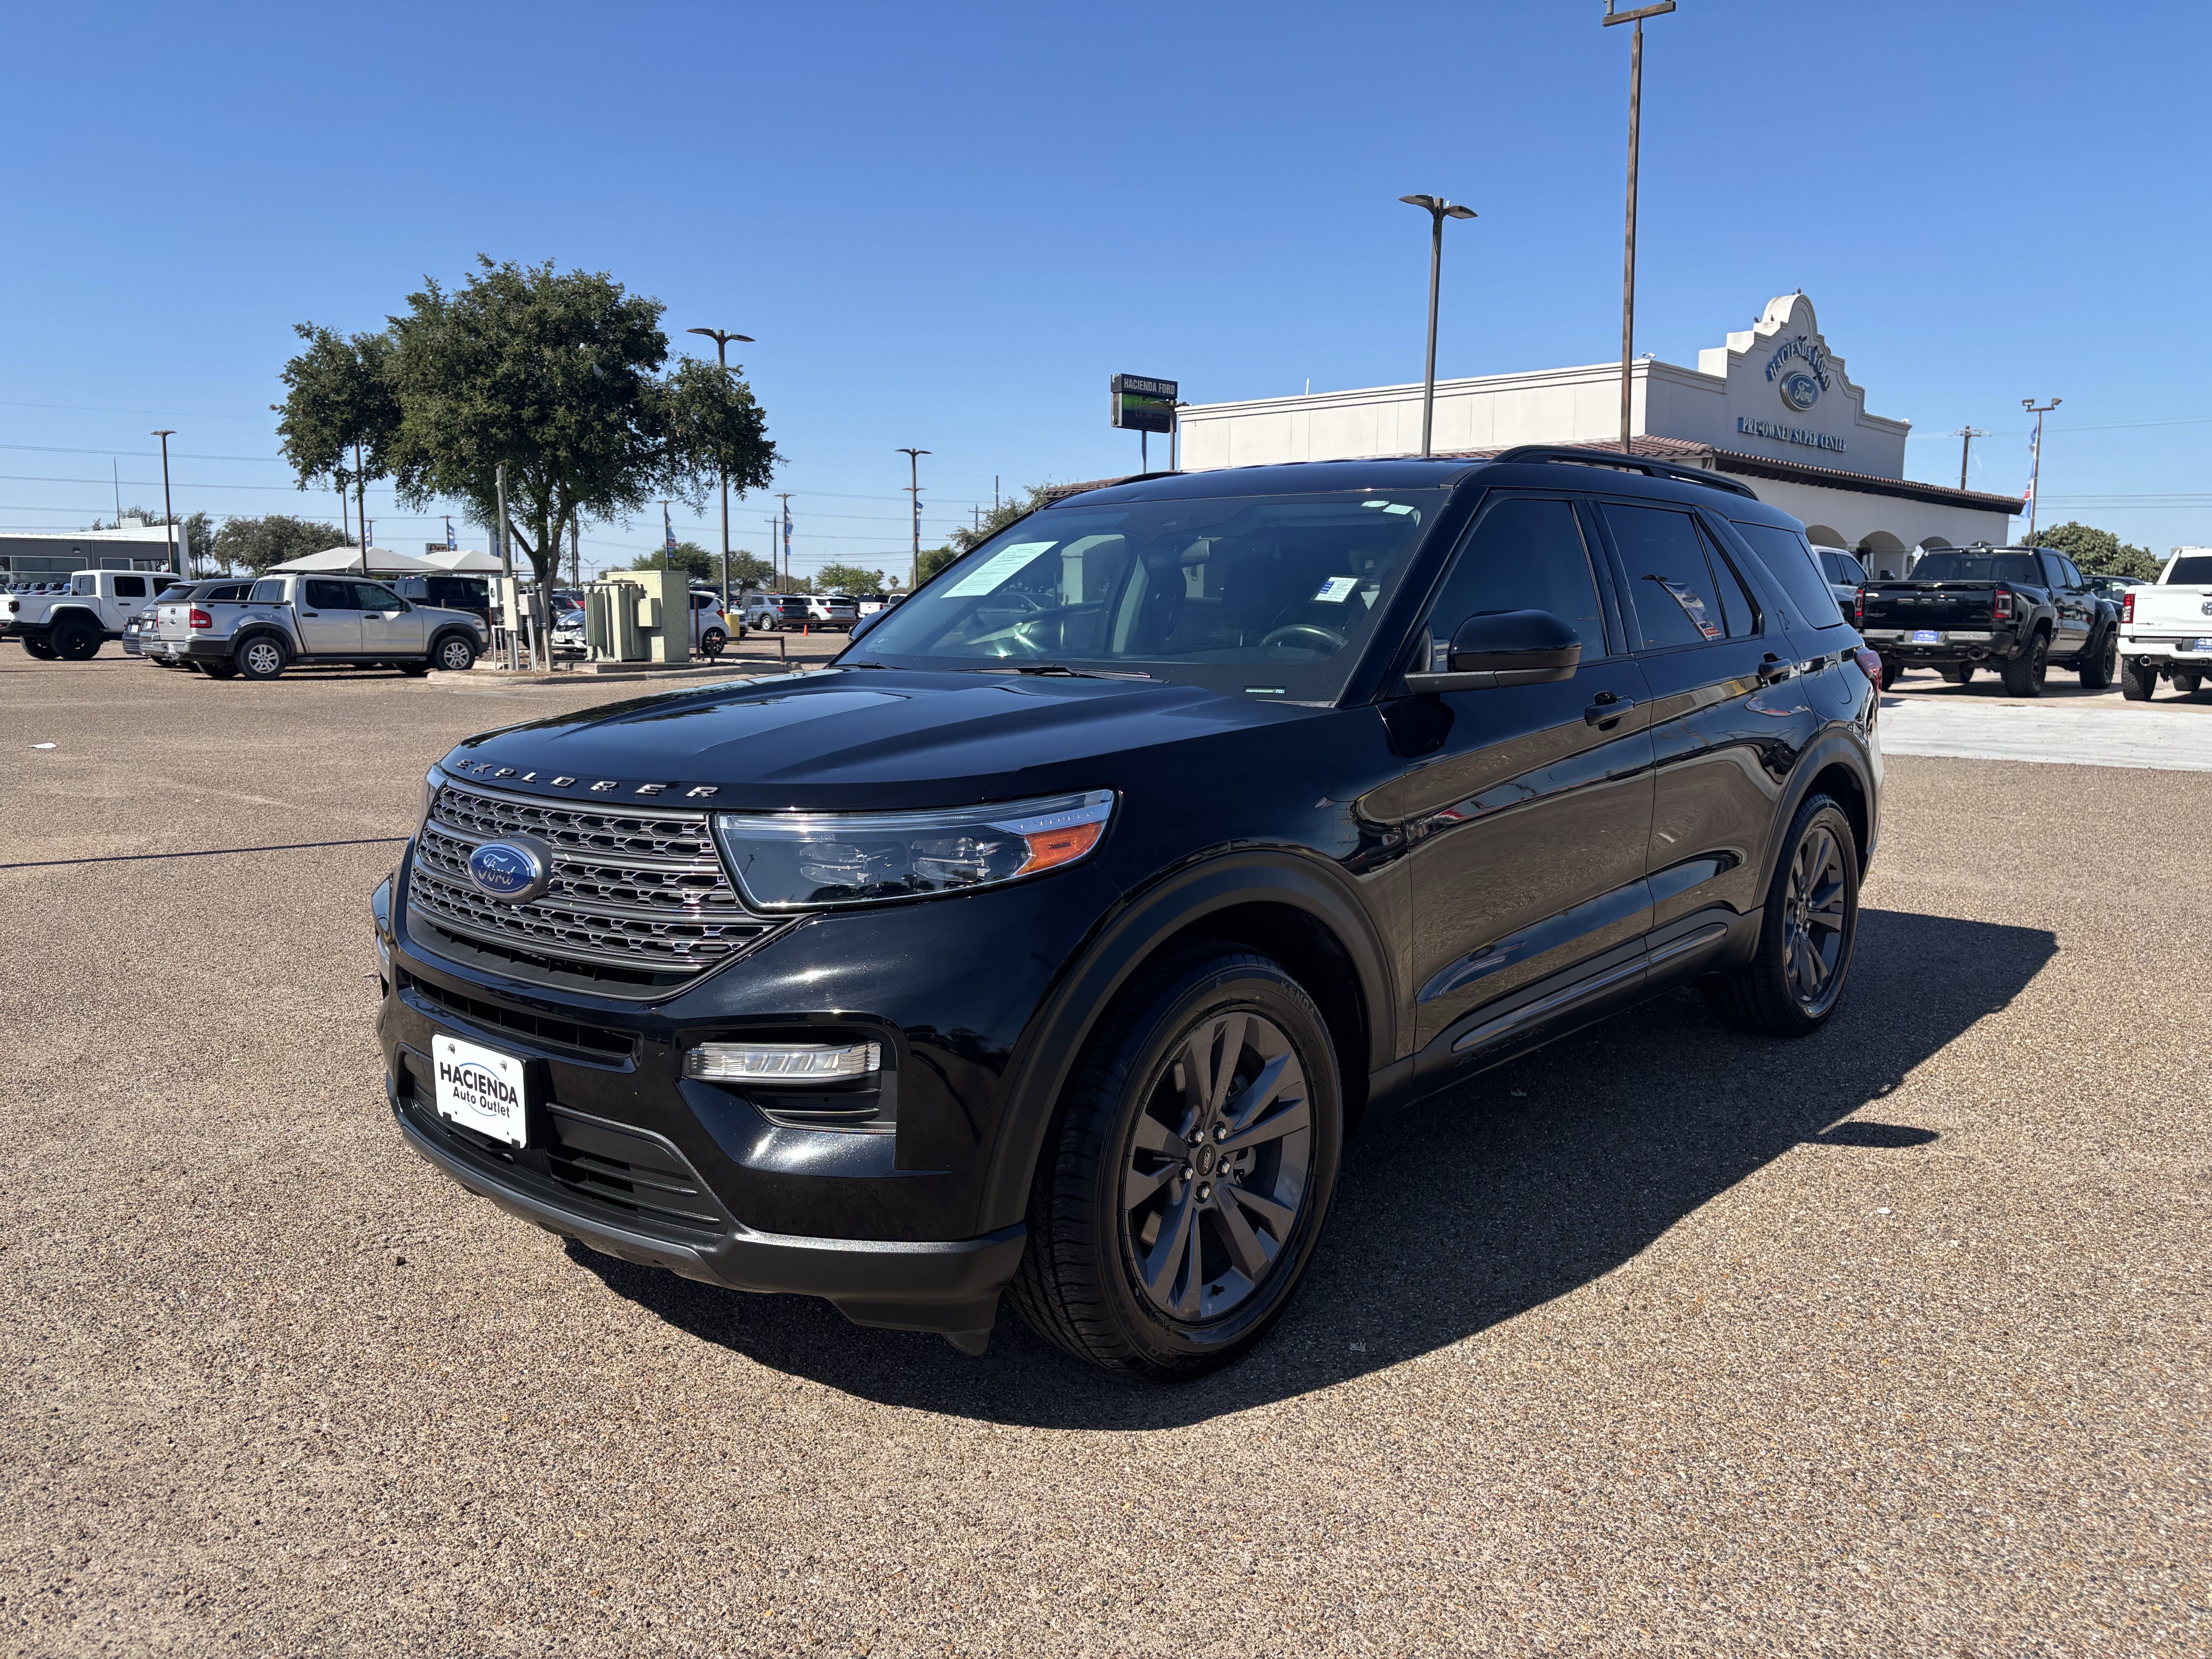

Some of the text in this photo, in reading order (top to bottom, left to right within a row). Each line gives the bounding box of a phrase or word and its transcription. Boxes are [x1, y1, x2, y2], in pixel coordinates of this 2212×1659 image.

[1768, 340, 1812, 380] HACIENDA
[1124, 378, 1175, 395] HACIENDA FORD
[1795, 380, 1814, 404] Ford
[1742, 417, 1847, 452] PRE-OWNED SUPER CENTER
[456, 759, 720, 799] EXPLORER
[478, 854, 516, 886] Ford
[1278, 979, 1315, 1020] KENDA
[440, 1061, 519, 1108] HACIENDA
[453, 1086, 510, 1118] Auto Outlet
